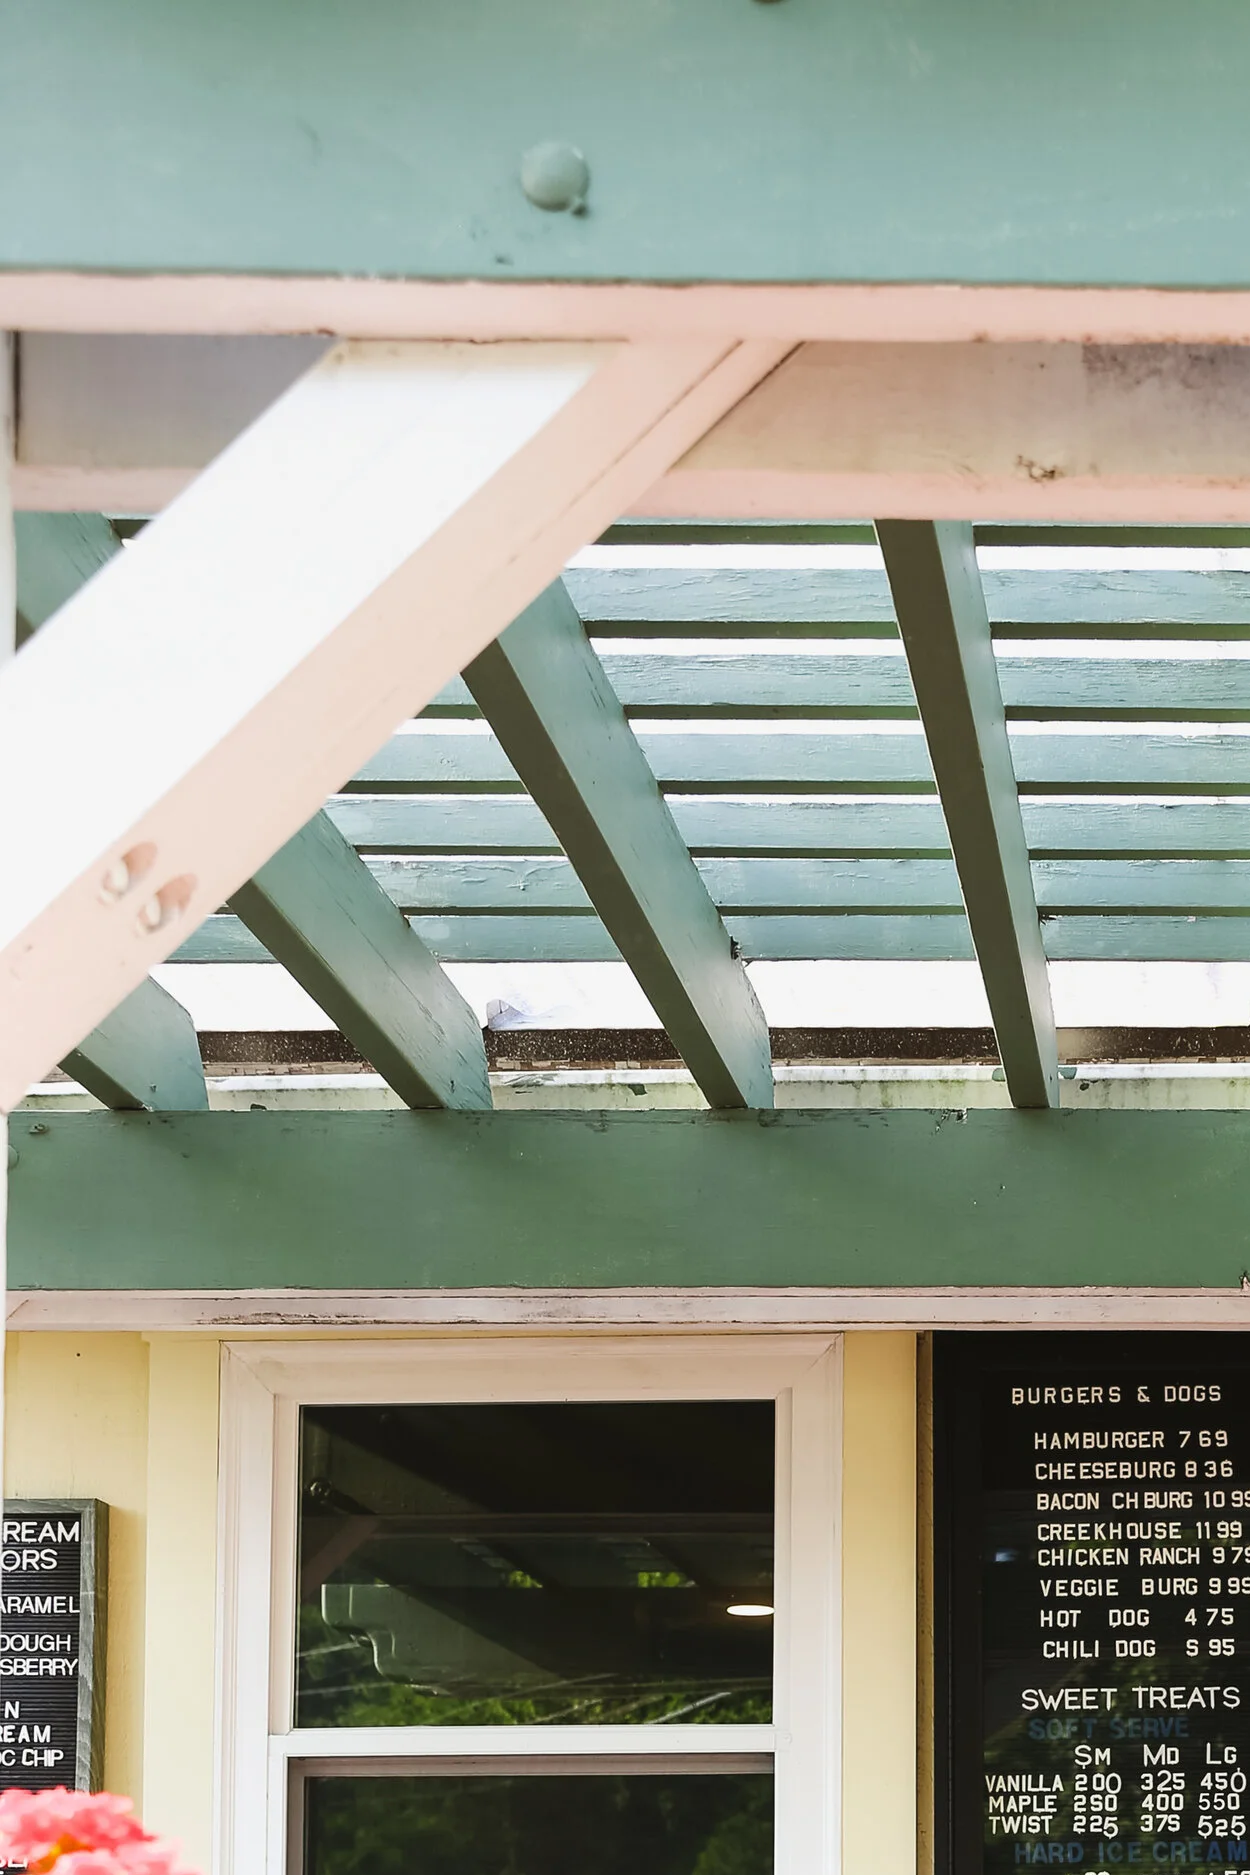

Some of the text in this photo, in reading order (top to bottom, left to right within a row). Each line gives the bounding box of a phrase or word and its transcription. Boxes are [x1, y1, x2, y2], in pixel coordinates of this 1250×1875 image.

[1012, 1386, 1220, 1405] BURGERS & DOGS
[1035, 1432, 1164, 1449] HAMBURGER
[1036, 1462, 1175, 1480] CHEESEBURG
[1037, 1493, 1099, 1510] BACON
[3, 1522, 79, 1543] REAM
[1038, 1522, 1181, 1541] CREEKHOUSE
[1038, 1548, 1128, 1566] CHICKEN
[1140, 1547, 1199, 1566] RANCH
[1040, 1579, 1118, 1596] VEGGIE
[1142, 1578, 1197, 1595] BURG
[1041, 1610, 1081, 1628] HOT
[1109, 1609, 1149, 1628] DOG
[1043, 1640, 1099, 1659] CHILI
[1116, 1640, 1155, 1657] DOG
[1022, 1686, 1240, 1711] SWEET TREATS
[0, 1725, 50, 1743] EAM
[1028, 1716, 1189, 1739] SOFT SERVE
[22, 1749, 64, 1766] CHIP
[986, 1775, 1064, 1792] VANILLA
[1141, 1770, 1185, 1795] 325
[989, 1795, 1057, 1816] MAPLE
[1142, 1791, 1183, 1815] 400
[1199, 1791, 1241, 1810] 550
[989, 1815, 1053, 1834] TWIST
[1015, 1841, 1247, 1863] HARD ICE CREAM
